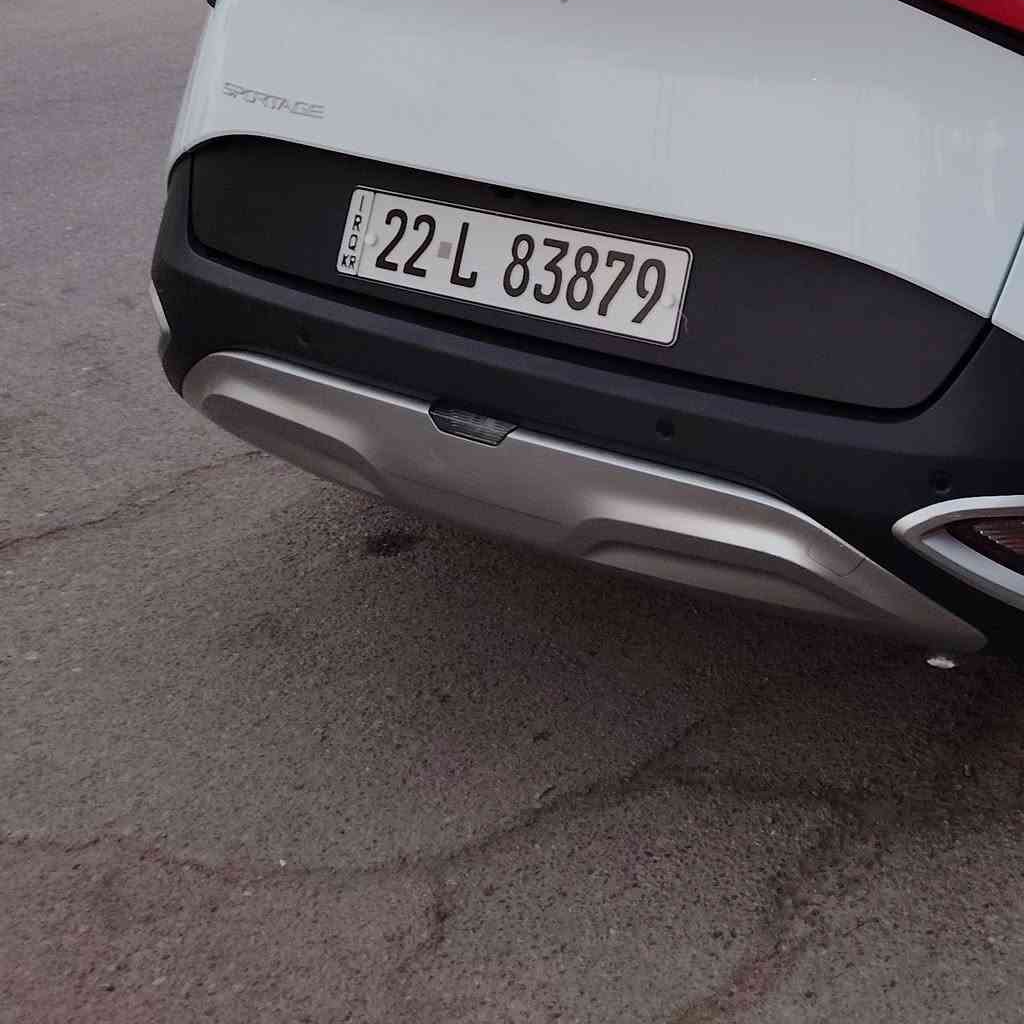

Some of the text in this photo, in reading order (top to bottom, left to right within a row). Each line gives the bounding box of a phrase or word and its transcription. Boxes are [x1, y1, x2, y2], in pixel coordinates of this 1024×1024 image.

[223, 81, 325, 119] SPORTAGE
[375, 208, 667, 324] 22 L 83879
